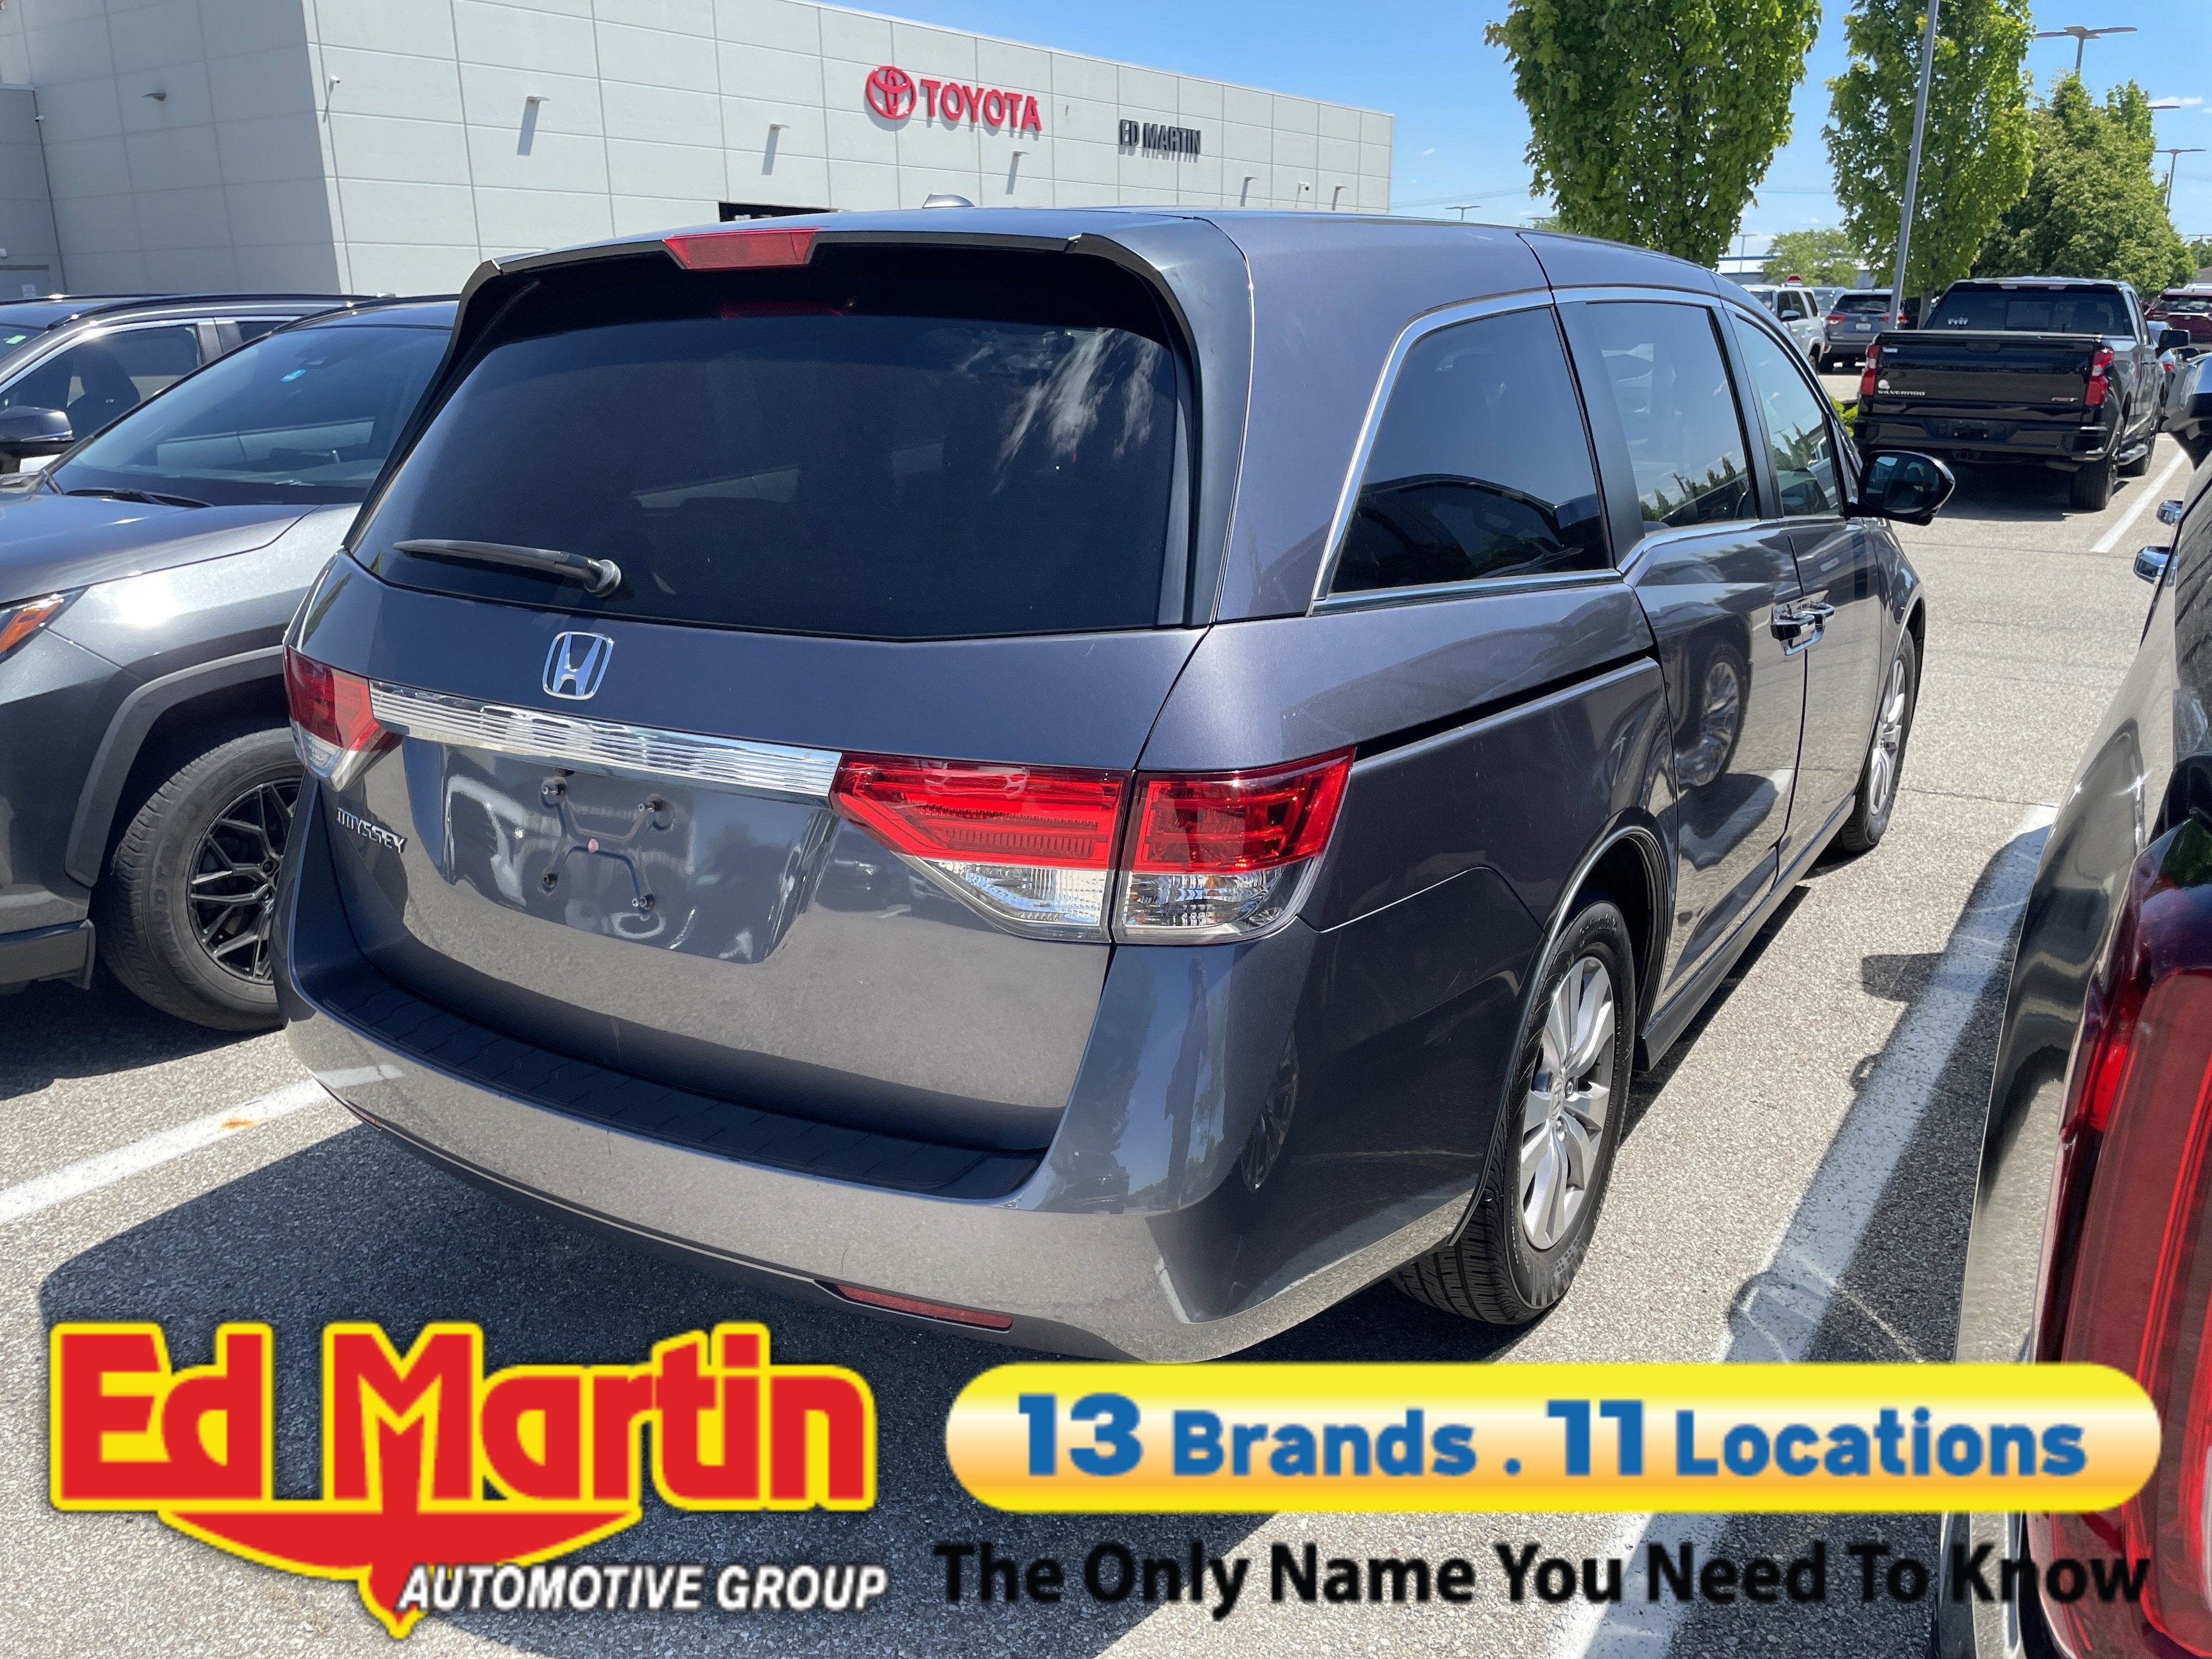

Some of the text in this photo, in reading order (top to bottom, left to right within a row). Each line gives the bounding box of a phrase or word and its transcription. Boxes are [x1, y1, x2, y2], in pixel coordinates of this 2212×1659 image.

[921, 78, 1042, 131] TOYOTA
[1119, 119, 1201, 155] ED MARTIN
